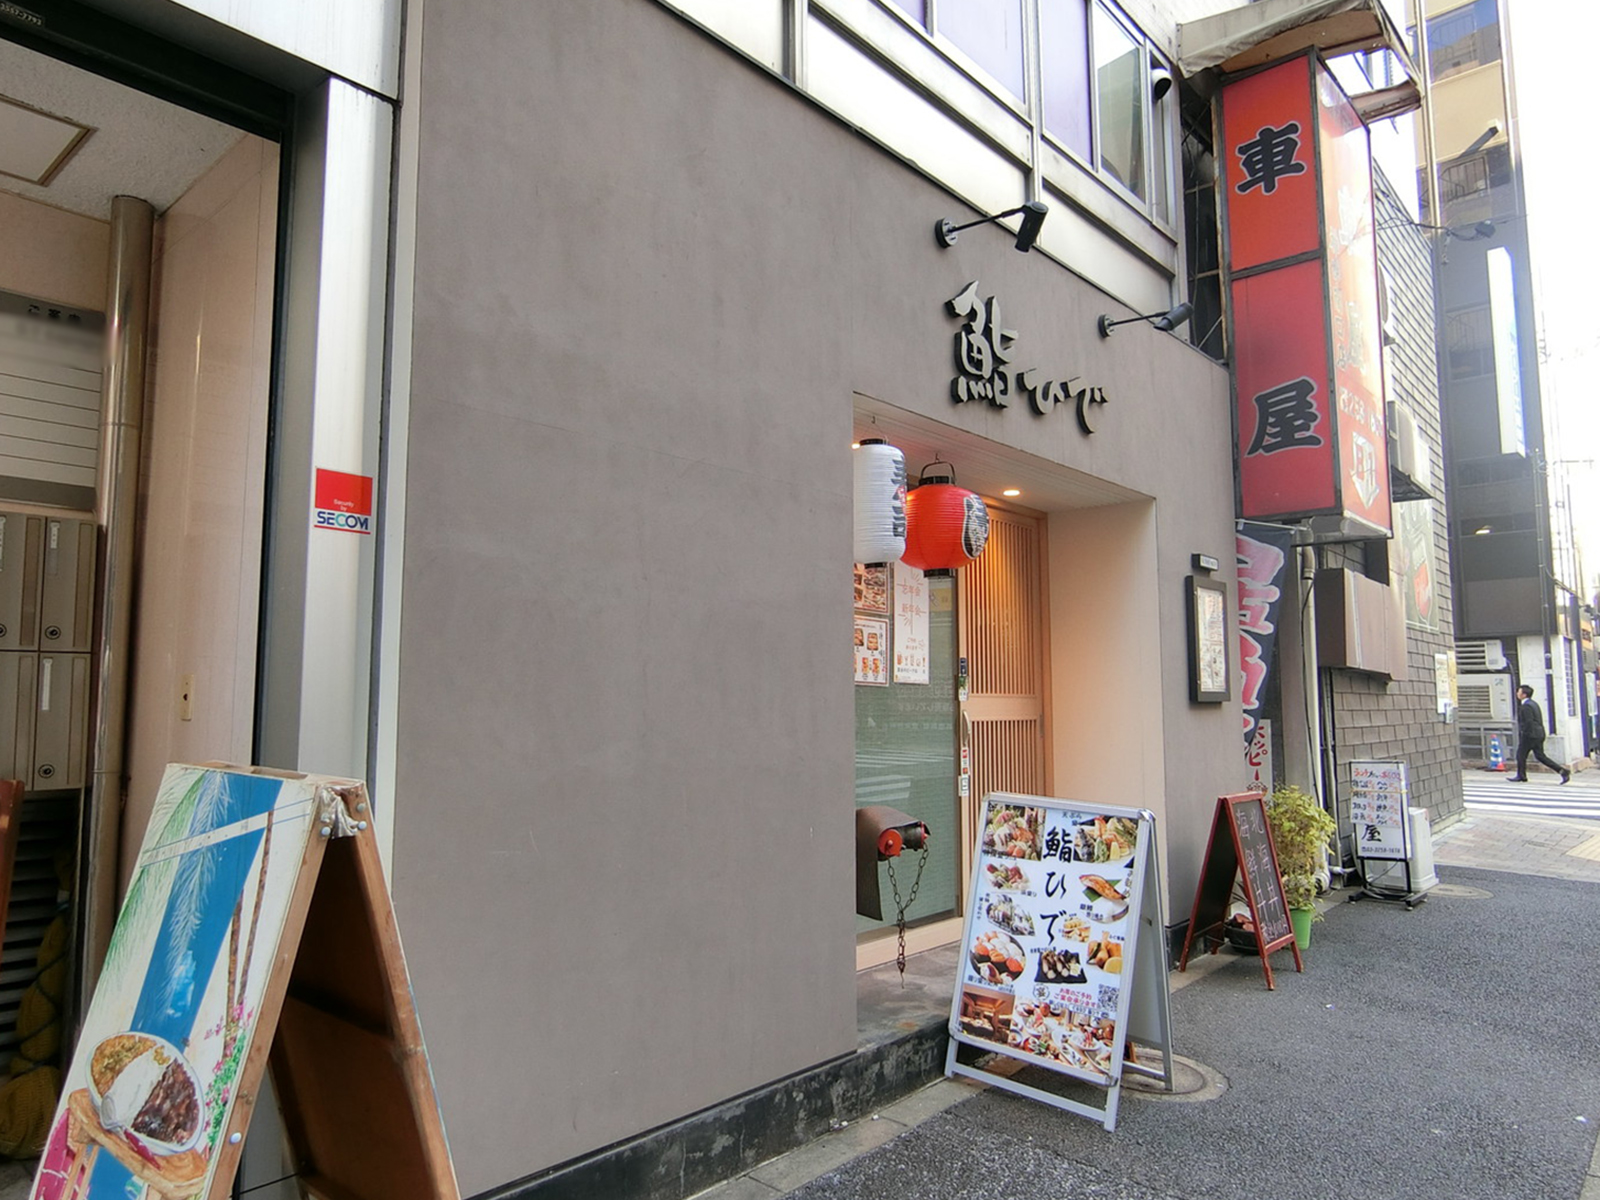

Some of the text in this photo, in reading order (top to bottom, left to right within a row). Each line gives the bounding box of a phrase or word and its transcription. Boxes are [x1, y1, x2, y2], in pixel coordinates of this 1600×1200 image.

[1235, 121, 1323, 458] 車屋
[944, 280, 1108, 434] 鮨ひで
[317, 510, 369, 530] SECOM
[1039, 825, 1073, 946] 鮨ひで
[1361, 823, 1382, 842] 屋
